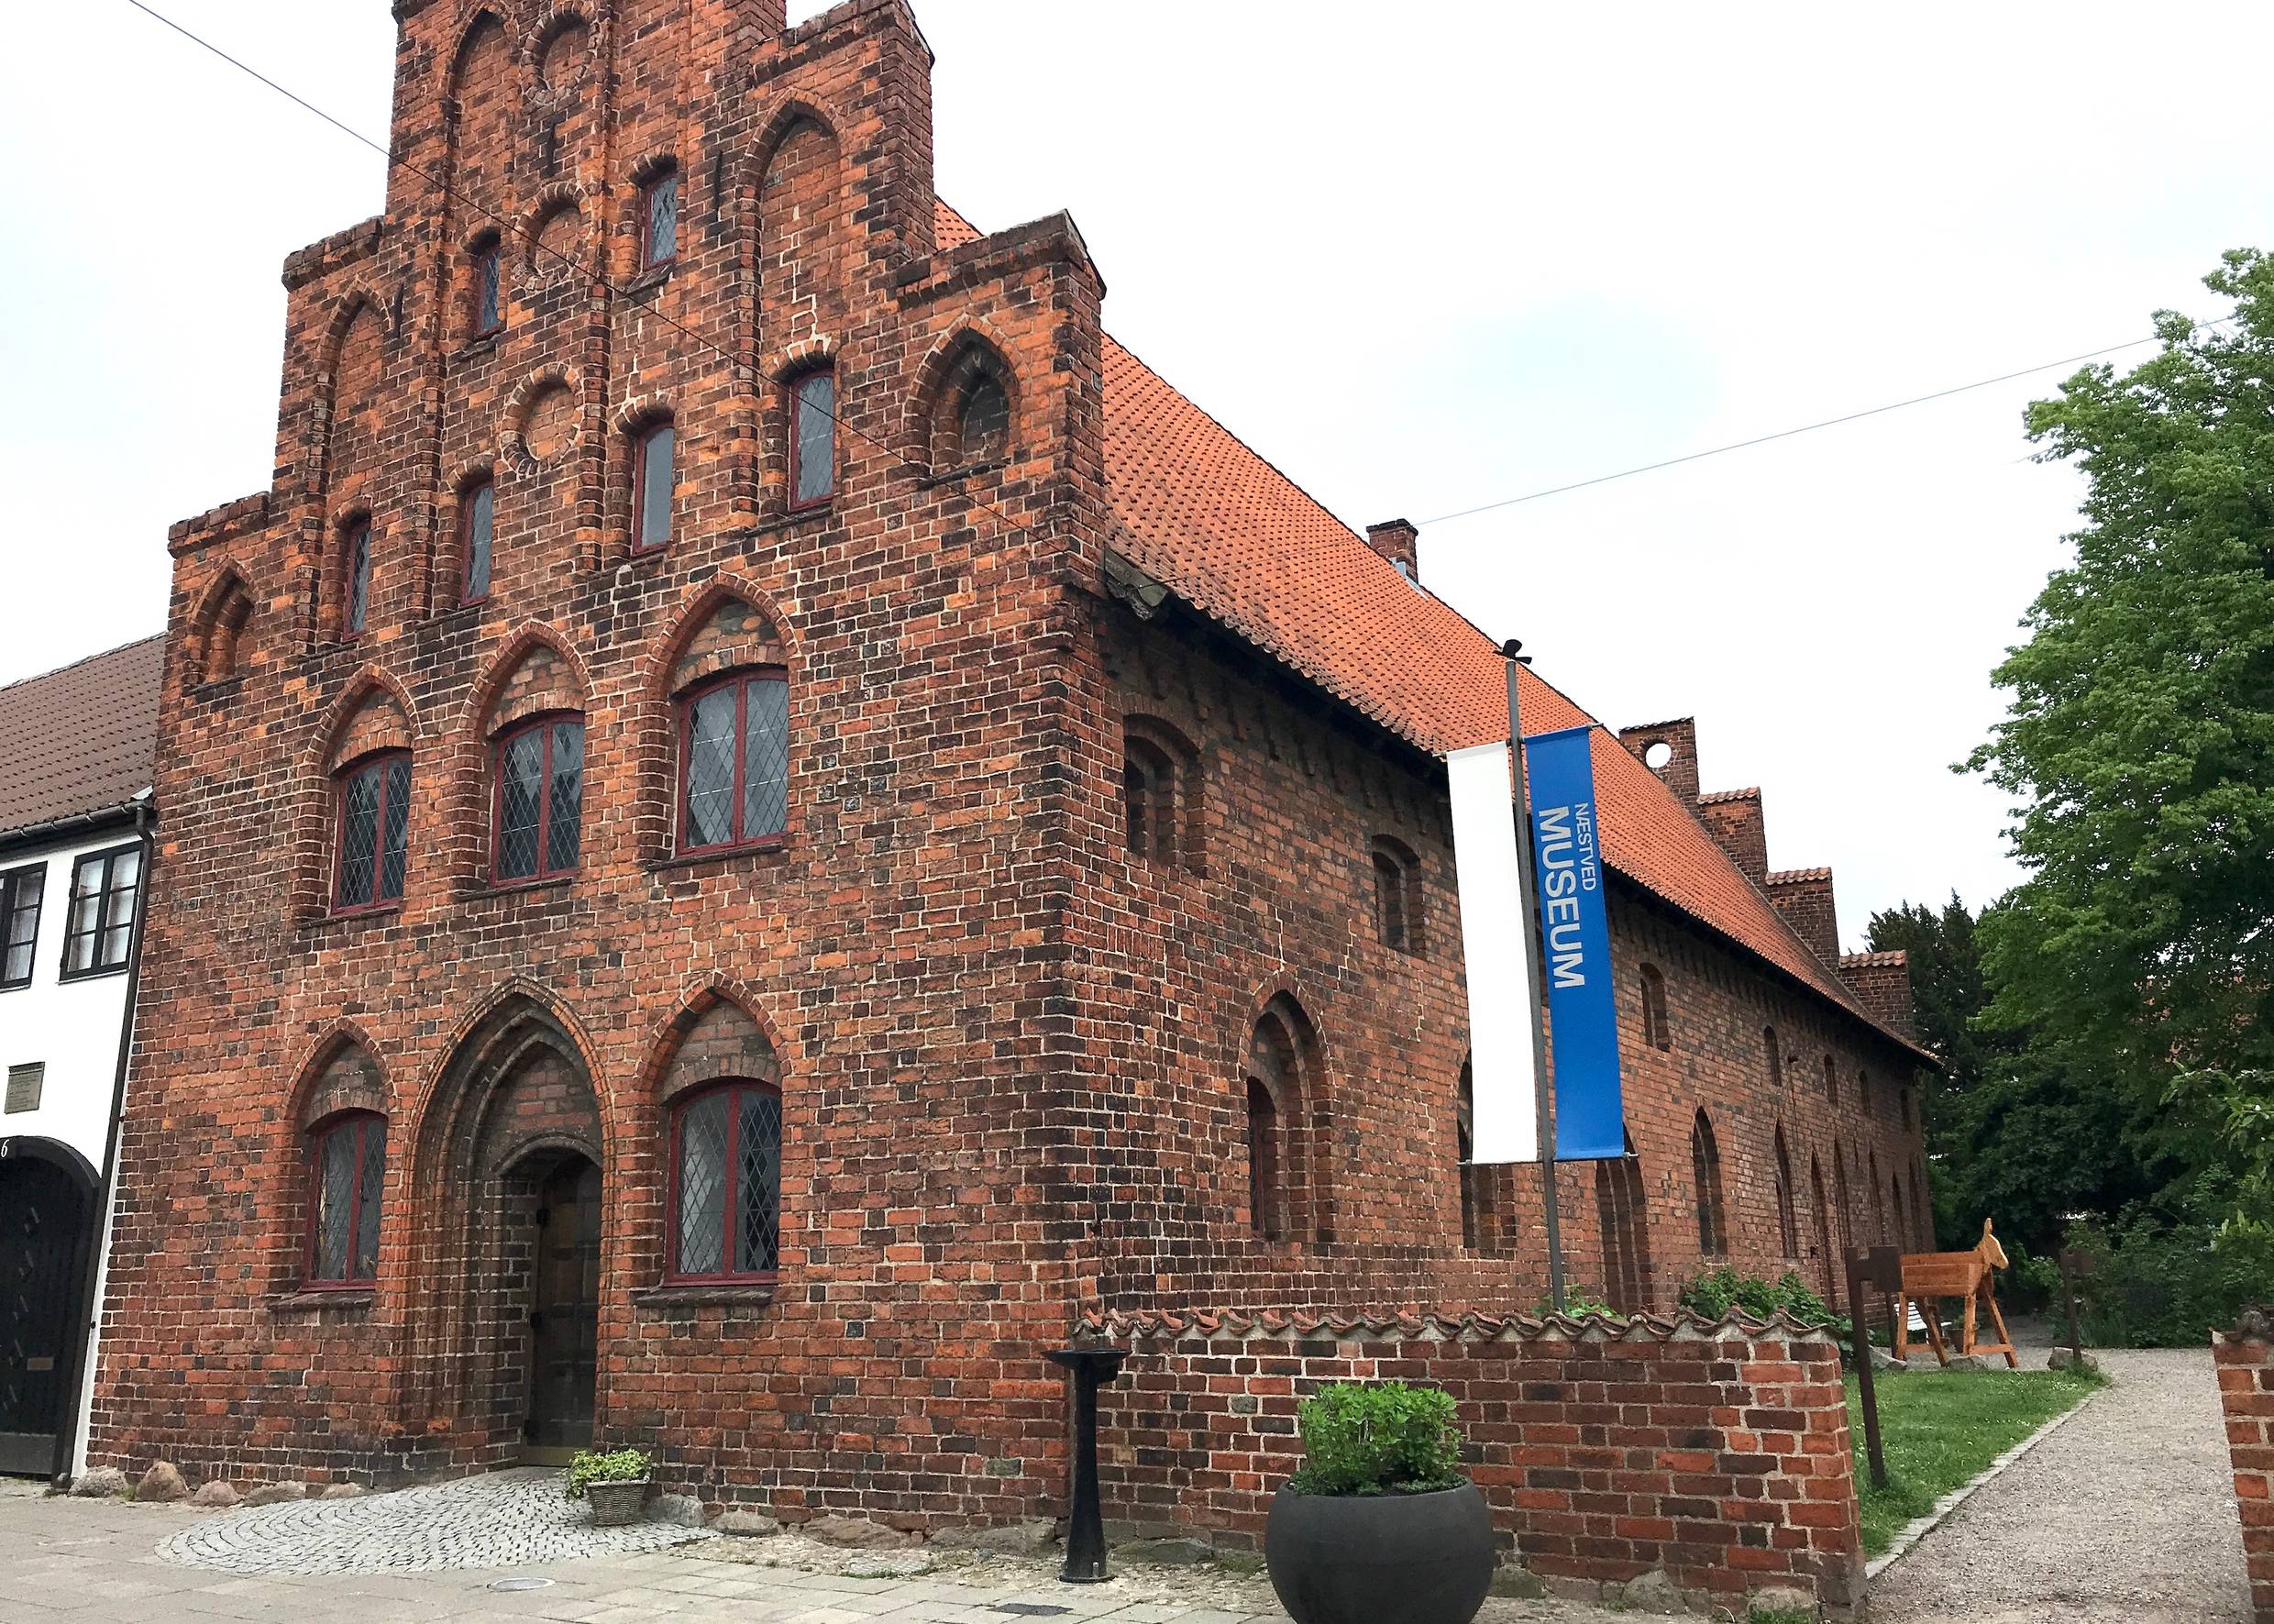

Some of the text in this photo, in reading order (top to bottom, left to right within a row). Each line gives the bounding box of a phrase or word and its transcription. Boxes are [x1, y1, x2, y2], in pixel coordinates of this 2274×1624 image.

[1574, 802, 1596, 891] NÆSTVED
[1539, 806, 1585, 989] MUSEUM
[1, 1139, 9, 1157] 6
